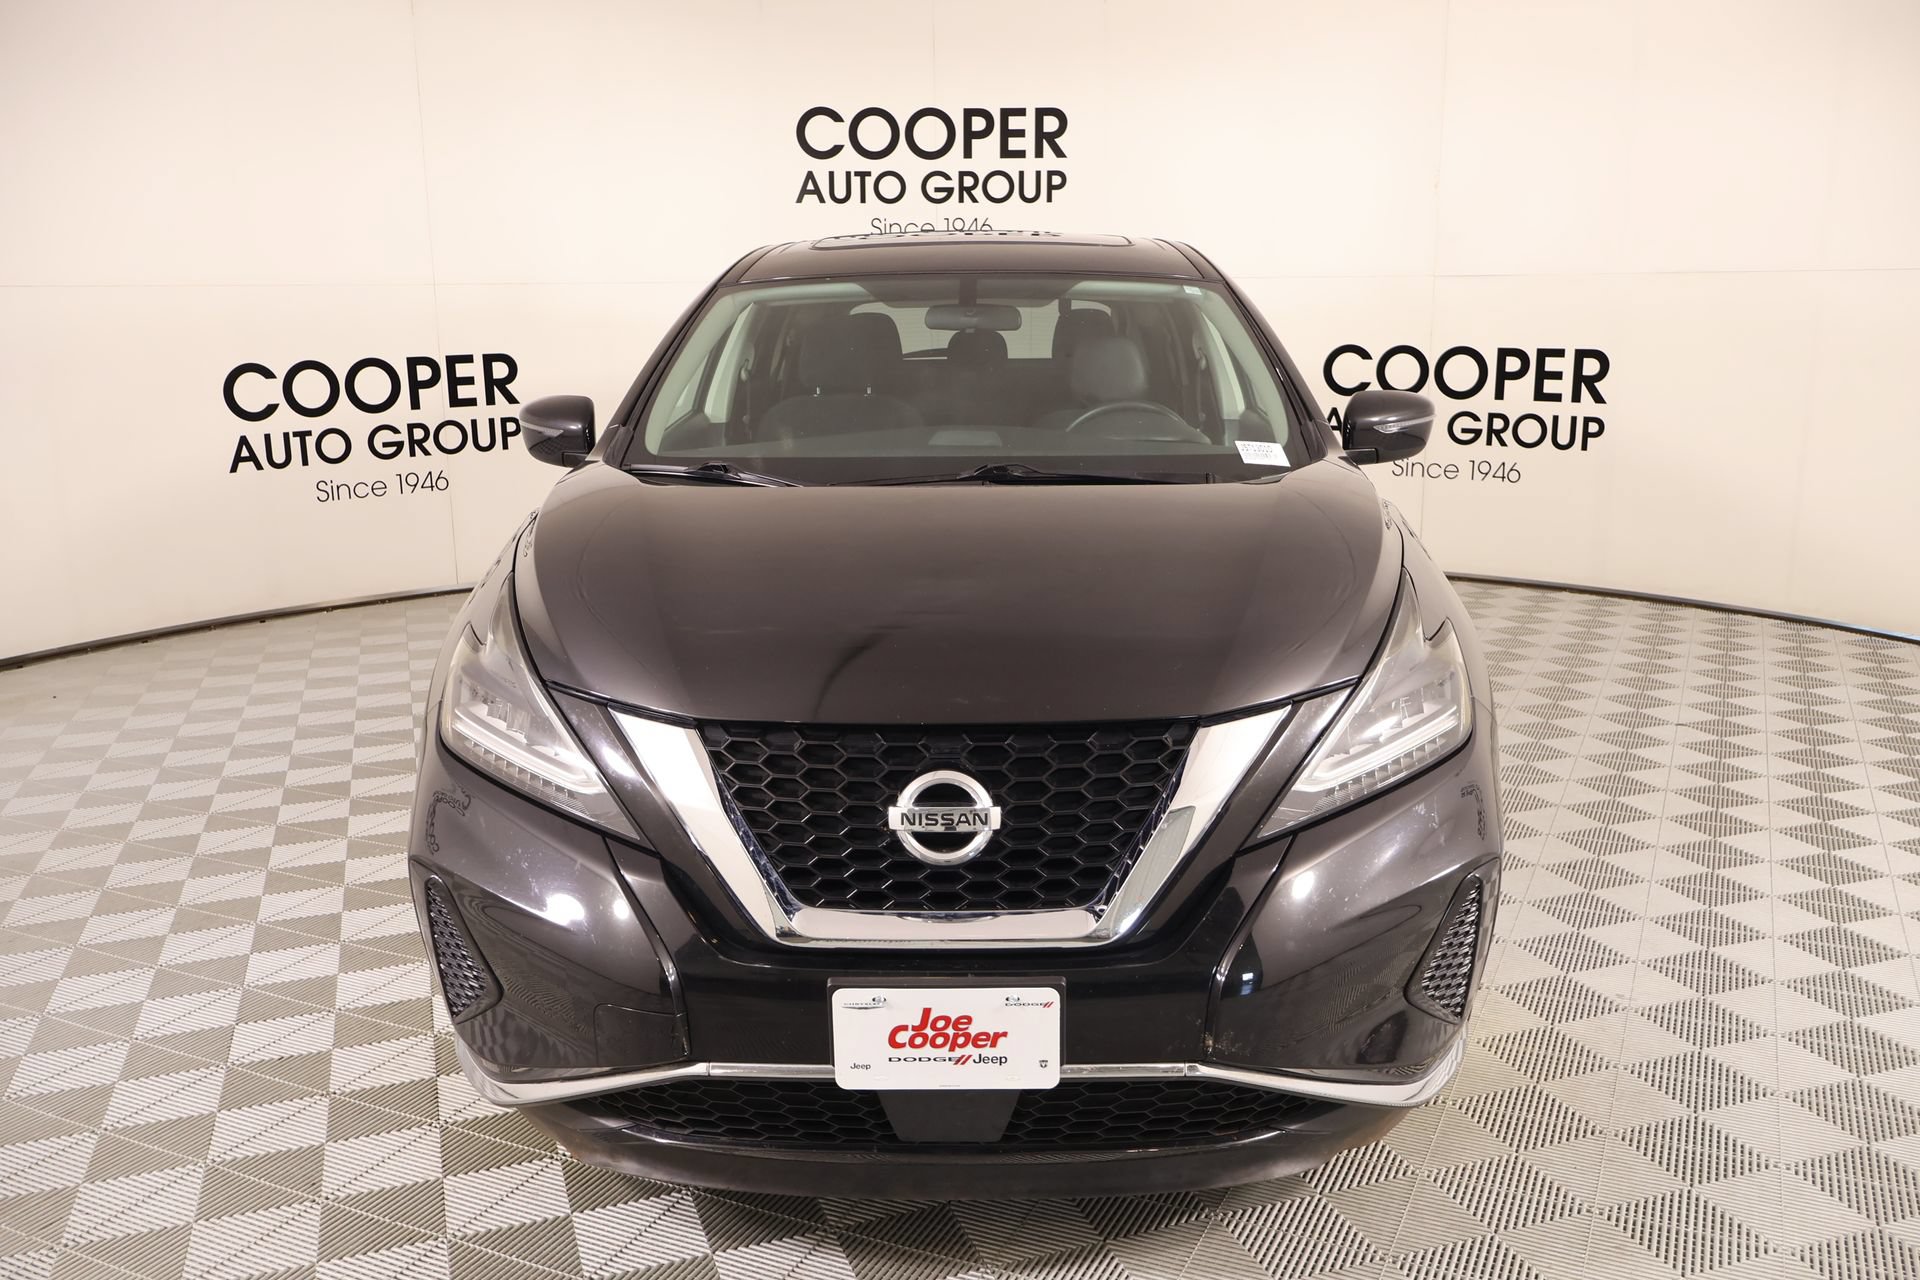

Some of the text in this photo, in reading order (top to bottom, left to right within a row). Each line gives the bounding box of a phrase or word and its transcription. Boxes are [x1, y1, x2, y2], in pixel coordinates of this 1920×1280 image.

[796, 106, 1068, 160] COOPER
[795, 170, 1067, 204] AUTO GROUP
[871, 217, 935, 235] Since
[223, 353, 520, 422] COOPER
[1323, 344, 1610, 404] COOPER
[229, 416, 521, 473] AUTO GROUP
[1447, 411, 1605, 451] GROUP
[1391, 458, 1521, 484] Since 1946
[316, 470, 449, 503] Since 1946
[900, 812, 988, 827] NISSAN
[911, 1007, 973, 1032] Joe
[888, 1024, 1008, 1052] Cooper
[850, 1062, 871, 1070] Jeep
[972, 1053, 1008, 1066] Jeep
